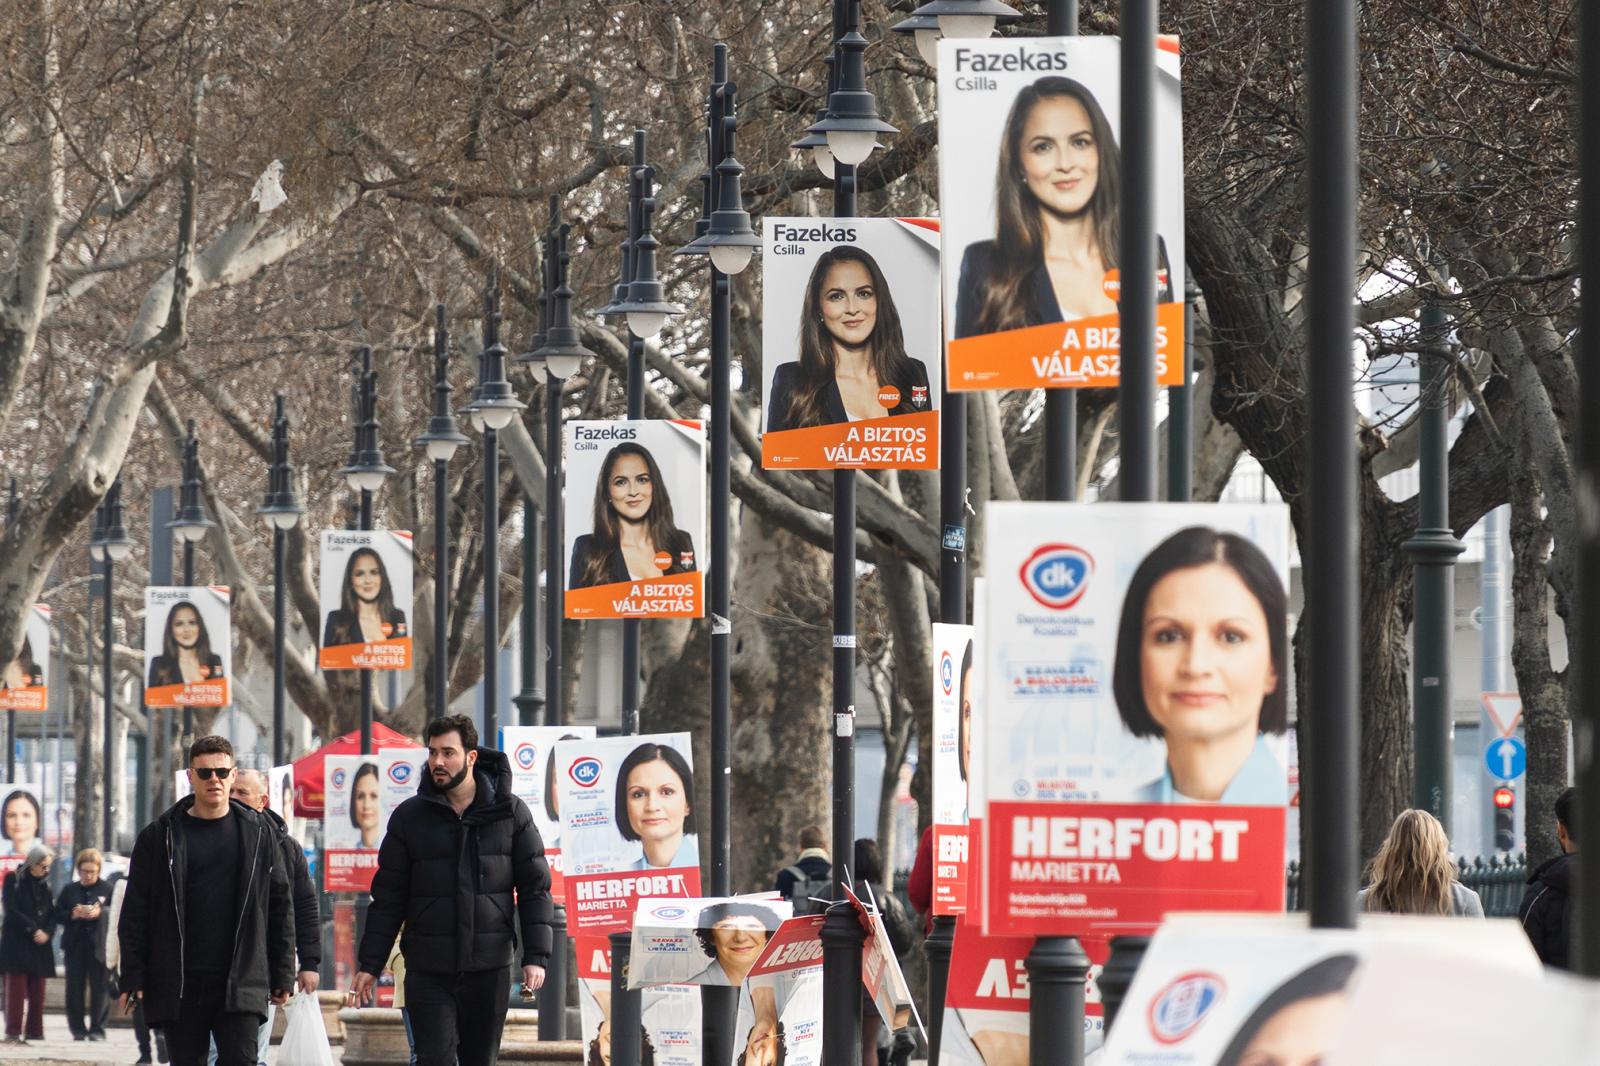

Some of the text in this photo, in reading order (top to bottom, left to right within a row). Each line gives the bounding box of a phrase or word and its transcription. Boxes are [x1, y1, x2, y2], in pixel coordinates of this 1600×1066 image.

[955, 48, 1067, 73] Fazekas
[955, 77, 997, 91] Csilla
[773, 224, 857, 242] Fazekas
[773, 245, 805, 255] Csilla
[1062, 326, 1168, 349] A BIZS
[1031, 351, 1168, 378] VÁLASZS
[575, 425, 637, 440] Fazekas
[847, 427, 927, 442] A BIZTOS
[574, 442, 599, 451] Csilla
[824, 443, 927, 463] VÁLASZTÁS
[327, 534, 371, 544] Fazekas
[1040, 561, 1076, 589] dk
[630, 584, 694, 597] A BIZTOS
[612, 598, 694, 613] VÁLASZTÁS
[364, 645, 406, 656] A BIZTOS
[578, 766, 595, 777] dk
[1012, 816, 1249, 862] HERFORT
[1010, 861, 1122, 884] MARIETTA
[576, 874, 684, 900] HERFORT
[577, 900, 628, 912] MARIETTA
